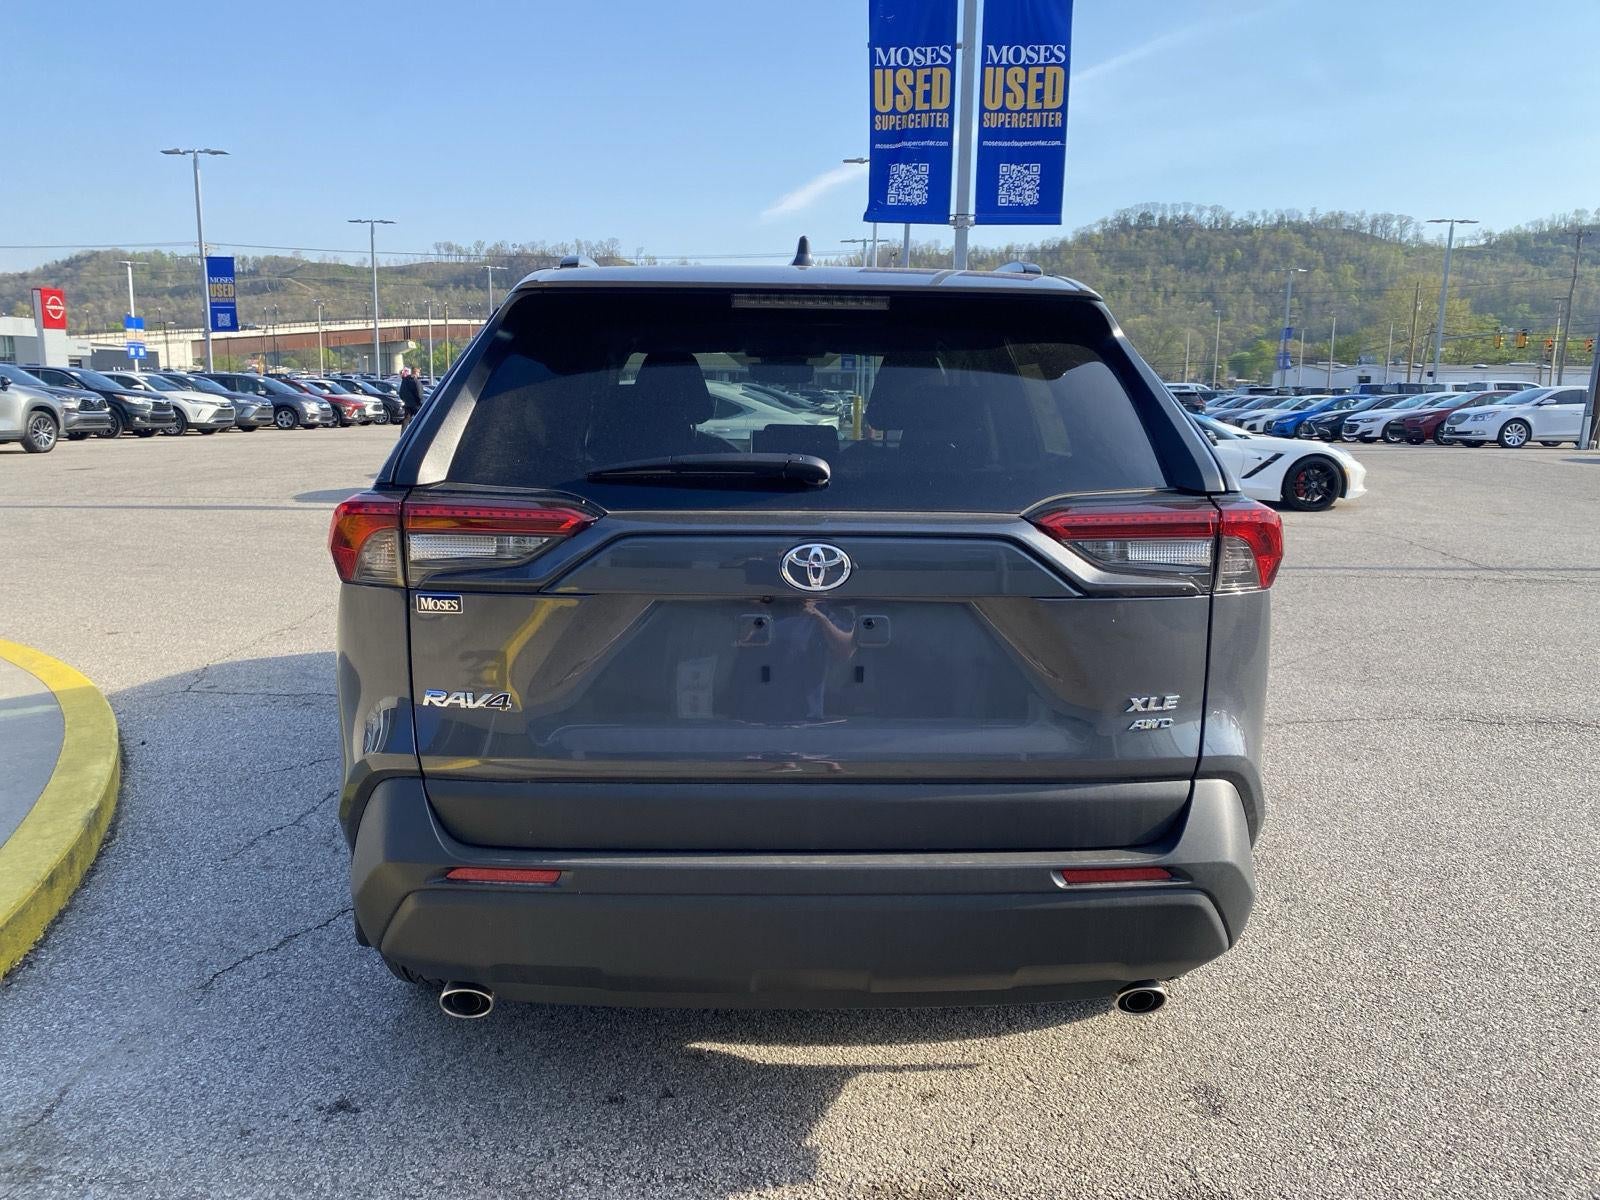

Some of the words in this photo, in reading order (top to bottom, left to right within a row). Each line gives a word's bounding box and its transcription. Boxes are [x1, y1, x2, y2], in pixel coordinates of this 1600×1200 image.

[875, 45, 952, 66] MOSES
[986, 44, 1066, 64] MOSES
[874, 67, 951, 112] USED
[983, 67, 1065, 110] USED
[875, 112, 949, 131] SUPERCENTER
[983, 112, 1062, 128] SUPERCENTER
[209, 284, 235, 297] USED
[421, 598, 458, 610] MOSES
[423, 689, 512, 711] RAV4
[1125, 696, 1180, 712] XLE
[1128, 718, 1174, 730] AWD
